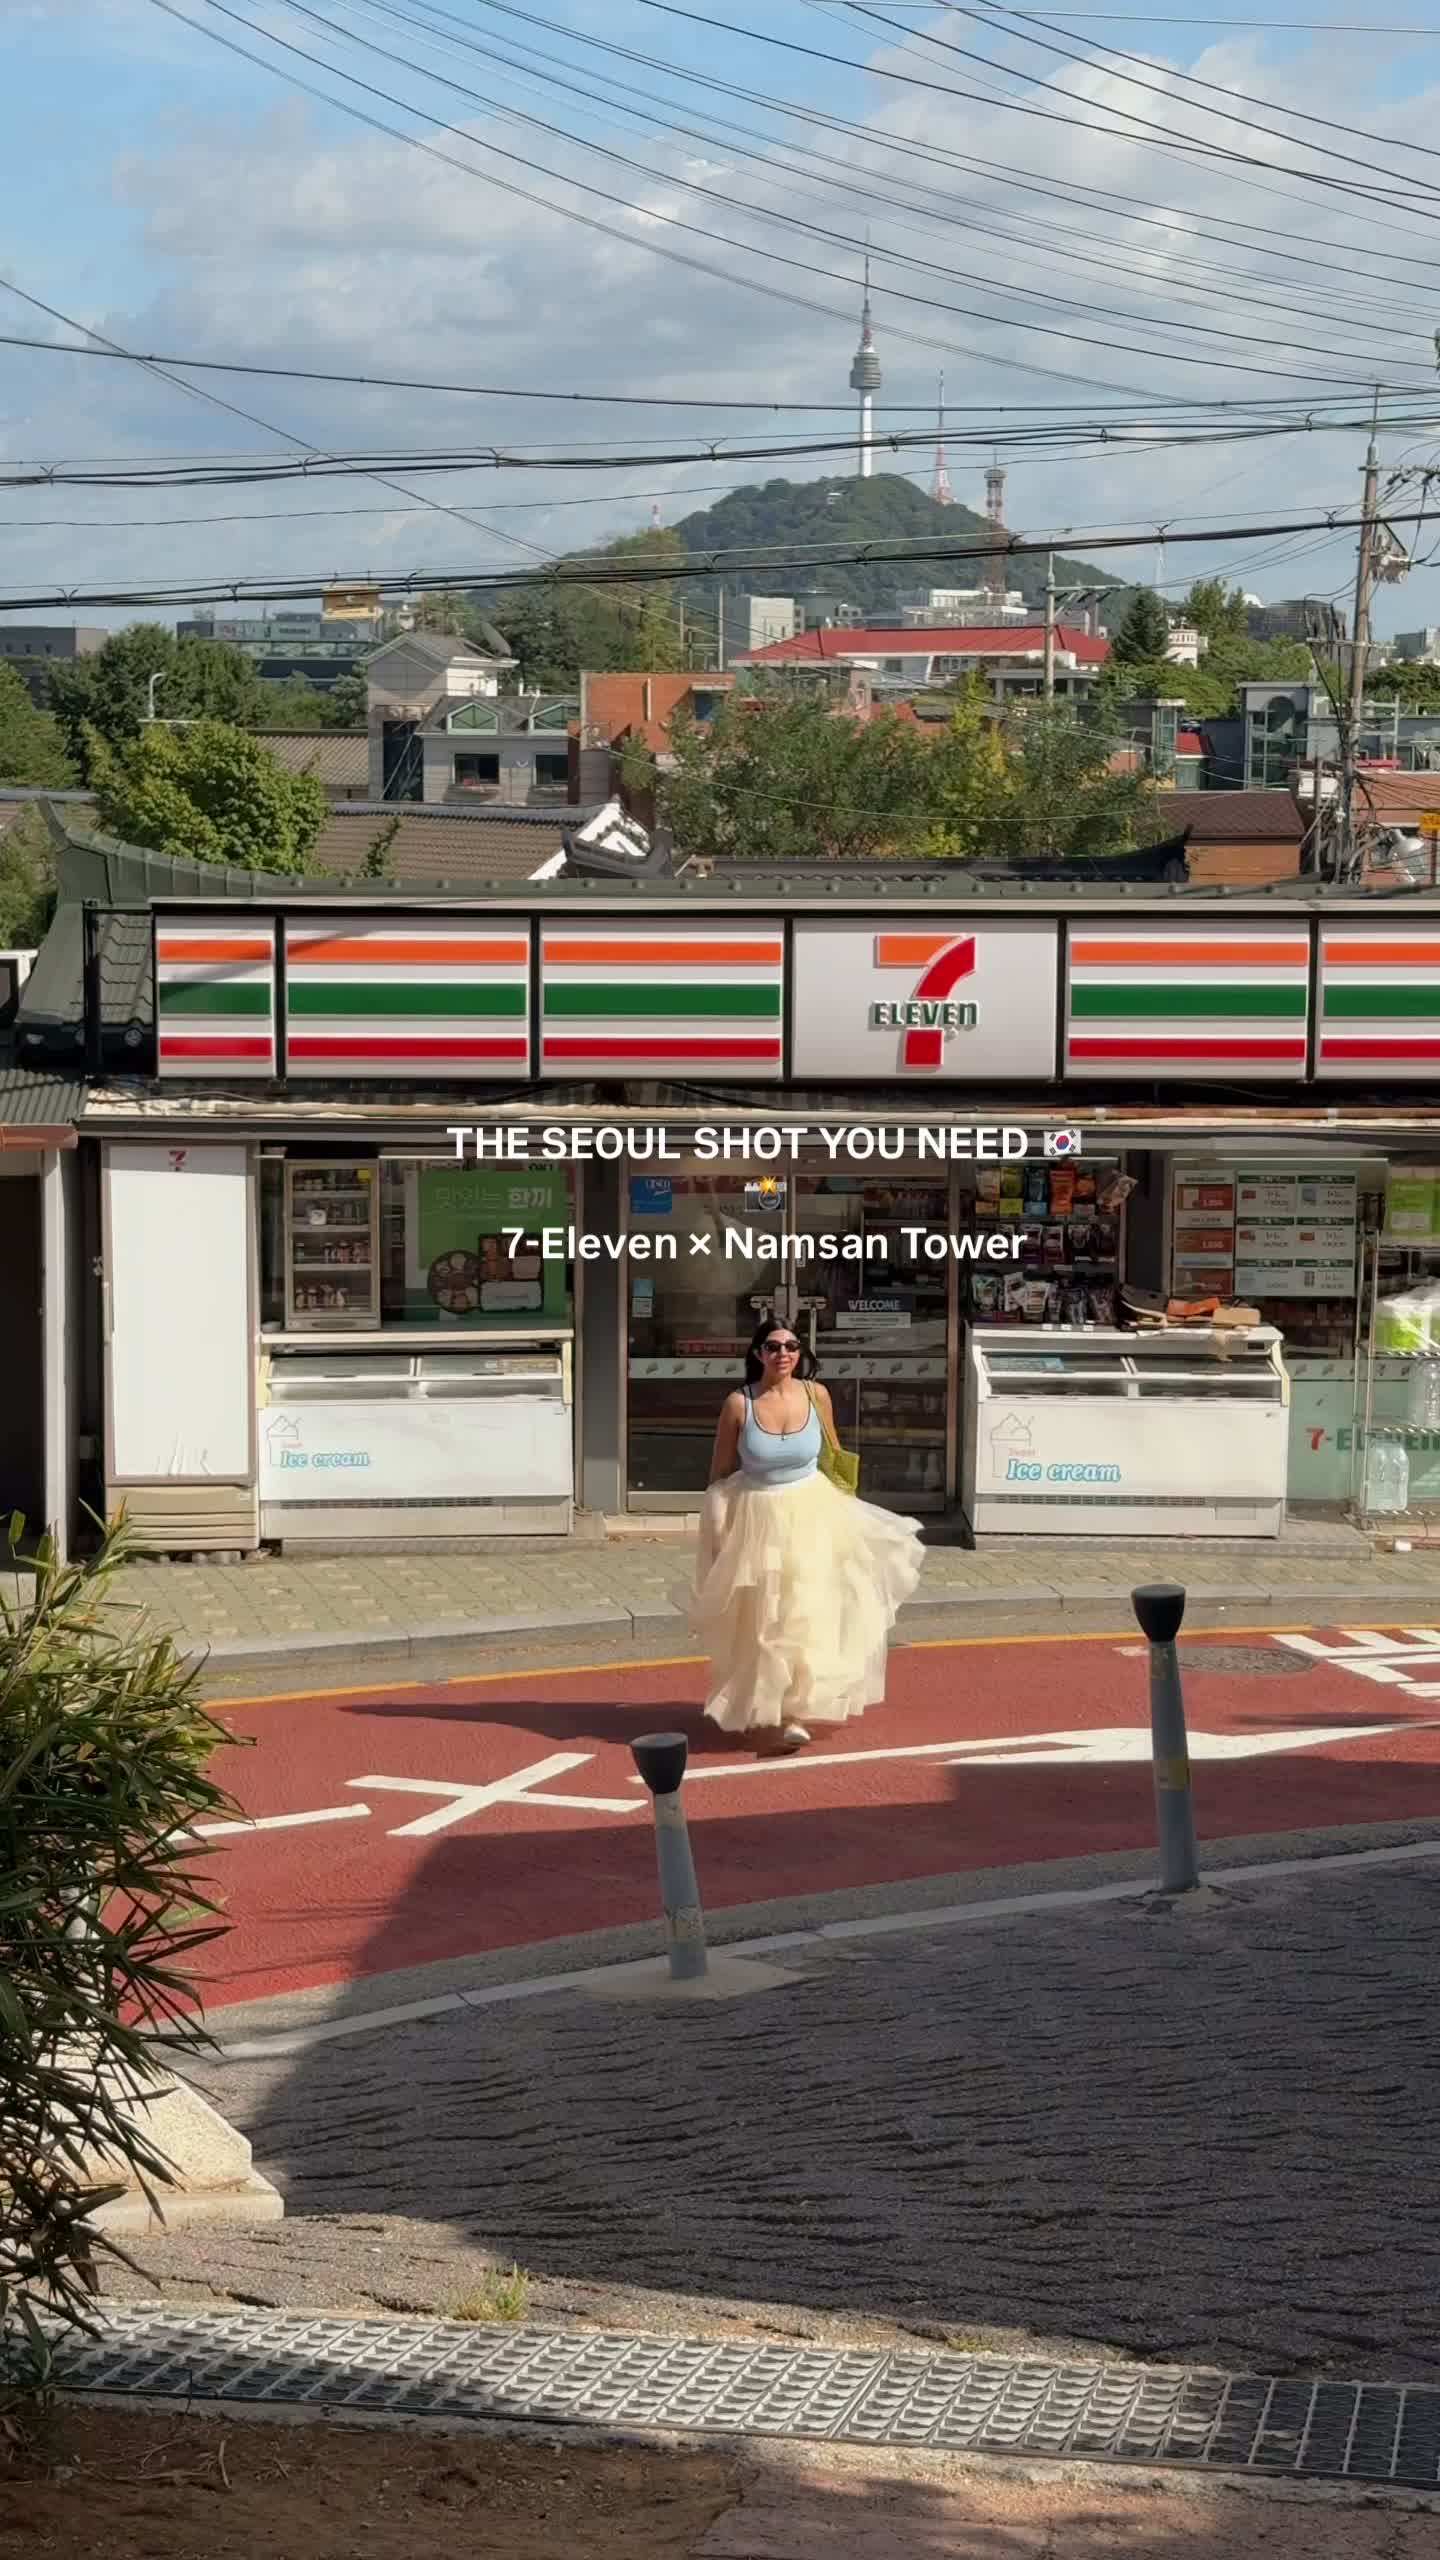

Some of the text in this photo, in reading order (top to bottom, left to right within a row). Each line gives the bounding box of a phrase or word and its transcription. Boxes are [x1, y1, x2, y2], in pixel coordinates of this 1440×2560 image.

[877, 935, 977, 1066] 7
[847, 1299, 901, 1311] WELCOME
[280, 1450, 370, 1469] Ice cream
[1006, 1458, 1122, 1482] Ice cream
